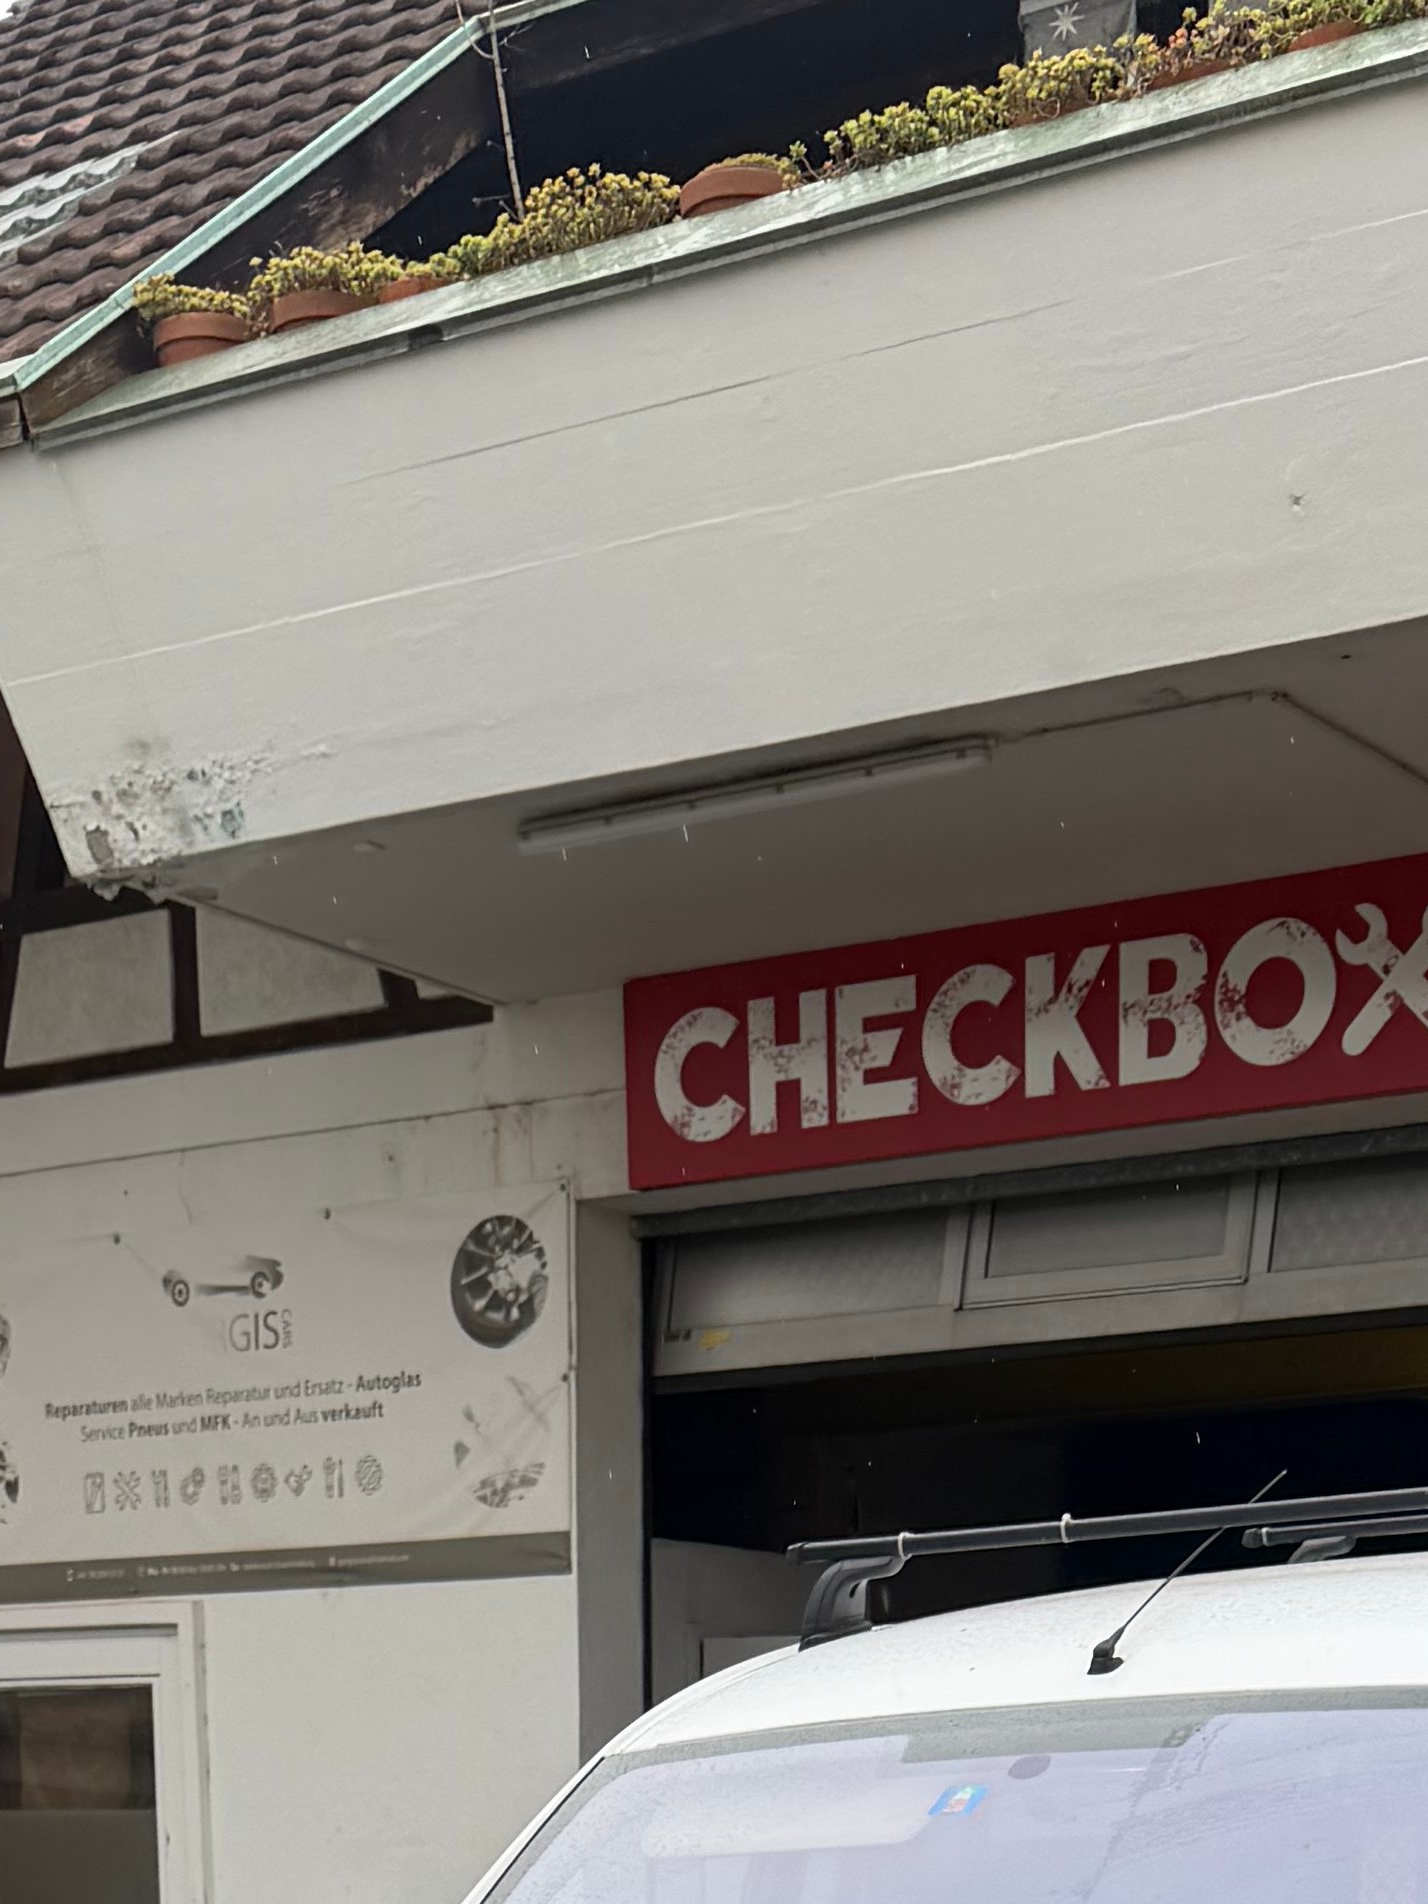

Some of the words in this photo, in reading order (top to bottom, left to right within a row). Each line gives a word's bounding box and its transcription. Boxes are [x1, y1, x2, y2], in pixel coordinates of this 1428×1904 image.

[44, 1399, 129, 1422] Reparaturen
[130, 1394, 153, 1412] alle
[155, 1390, 204, 1409] Marken
[205, 1386, 271, 1406] Reparatur
[274, 1382, 301, 1399] und
[304, 1378, 344, 1397] Ersatz
[355, 1370, 422, 1393] Autoglas
[80, 1425, 126, 1443] Service
[128, 1420, 169, 1438] Pneus
[172, 1416, 198, 1434] und
[200, 1412, 232, 1432] MFK
[263, 1407, 291, 1427] und
[321, 1399, 384, 1423] verkauft
